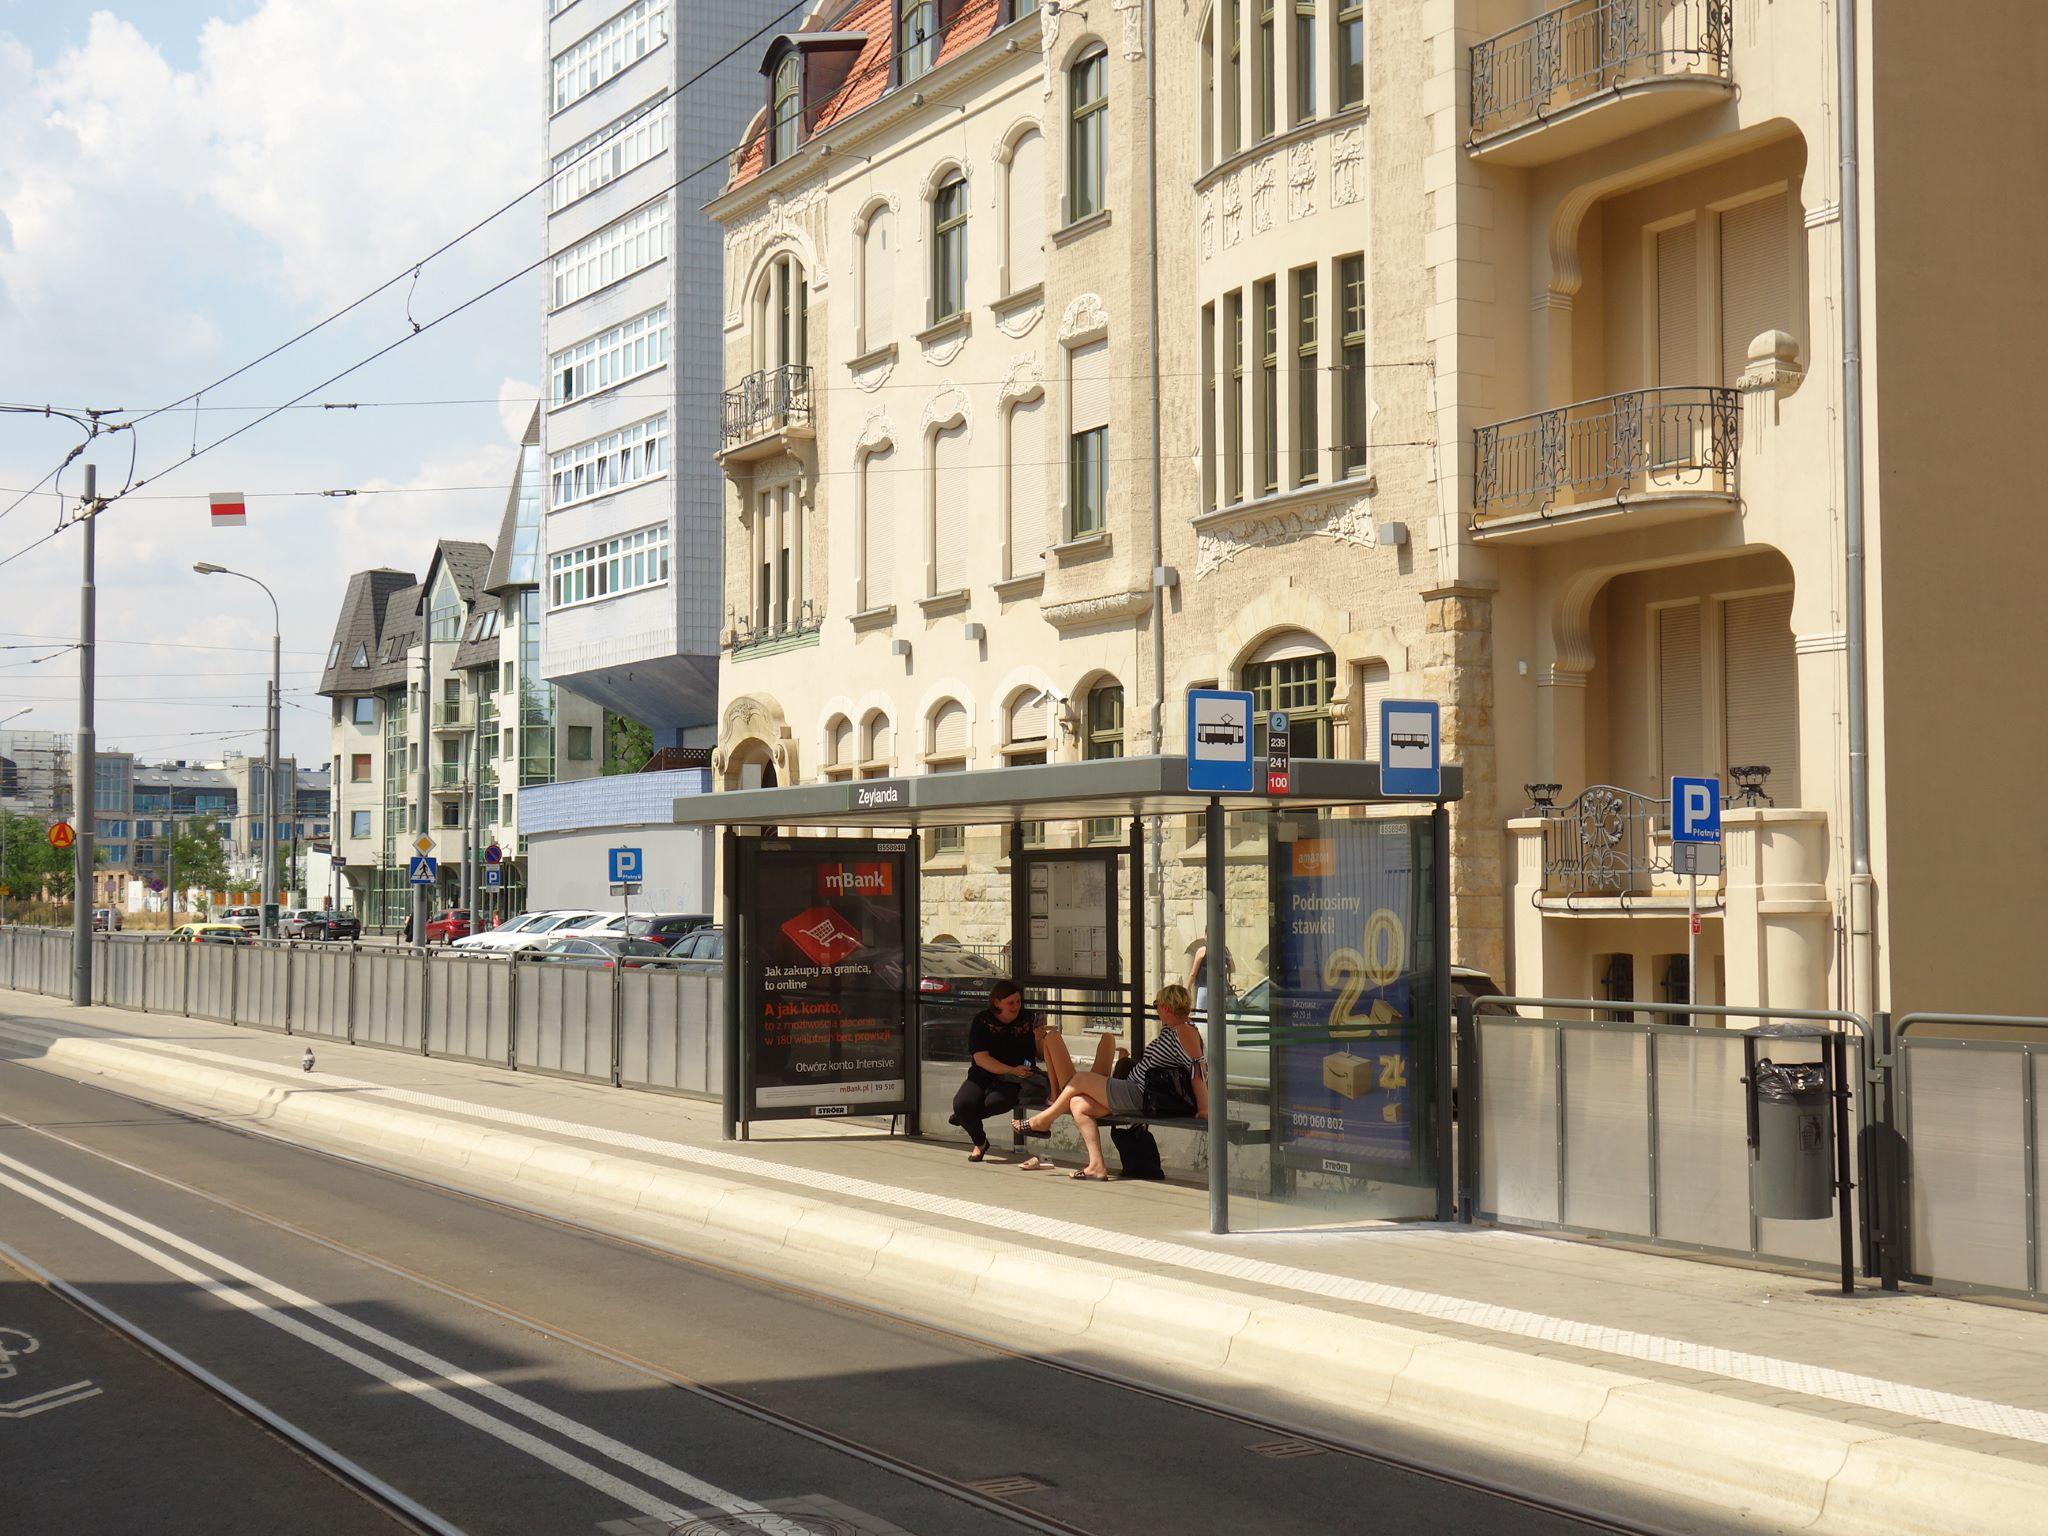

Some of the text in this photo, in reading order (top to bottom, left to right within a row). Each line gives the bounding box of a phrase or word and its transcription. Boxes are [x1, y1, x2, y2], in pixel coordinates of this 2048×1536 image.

[1276, 717, 1282, 727] 2
[1270, 738, 1286, 748] 239
[1270, 757, 1287, 768] 241
[1270, 777, 1287, 788] 100
[858, 786, 898, 807] Zeylanda
[1684, 784, 1711, 833] P
[52, 822, 70, 844] A
[617, 851, 635, 878] P
[1298, 852, 1329, 863] amazon
[489, 871, 498, 884] P
[825, 871, 885, 888] mBank
[1292, 893, 1360, 914] Podnosimy
[1292, 917, 1335, 934] stawki!
[765, 963, 872, 978] Jak zakupy za granicą,
[765, 979, 808, 991] to online
[765, 1003, 774, 1017] A
[777, 1002, 798, 1019] jak
[765, 1021, 774, 1032] to
[777, 1034, 793, 1045] 180
[795, 1057, 895, 1073] Otwórz konto Intensive
[1293, 1113, 1344, 1130] 800 060 802
